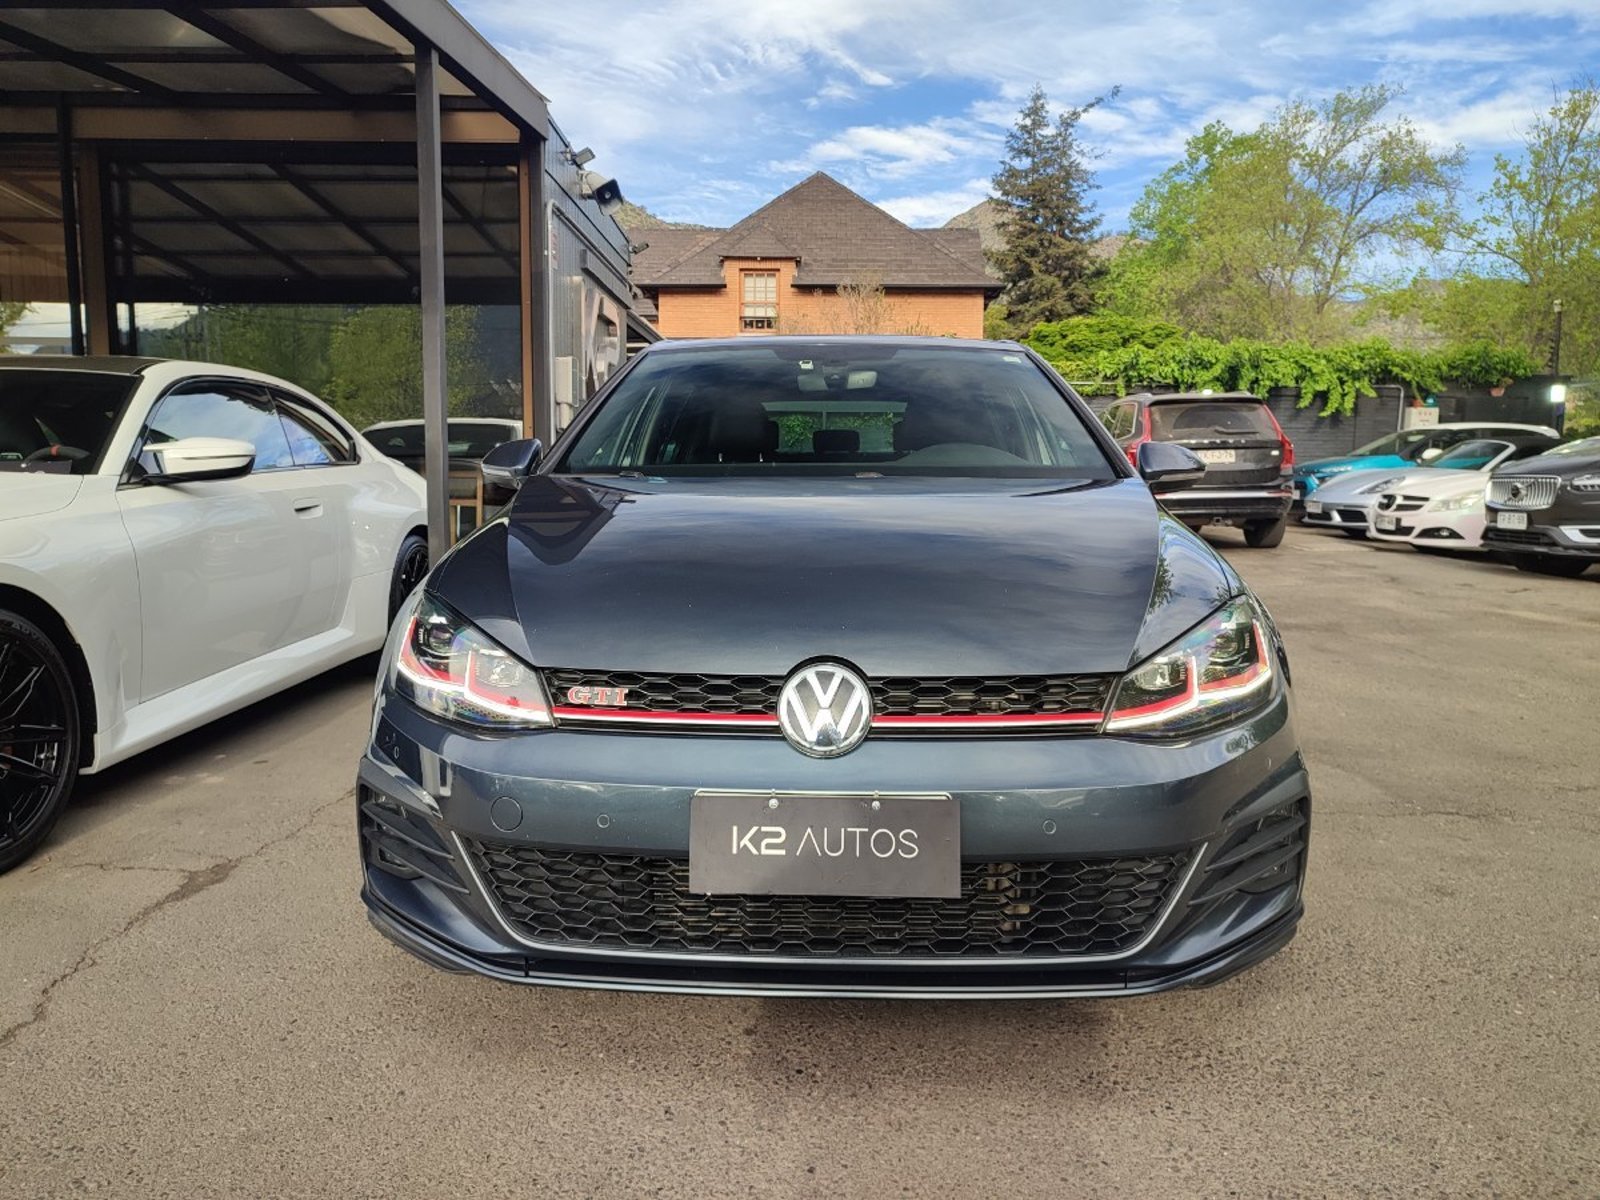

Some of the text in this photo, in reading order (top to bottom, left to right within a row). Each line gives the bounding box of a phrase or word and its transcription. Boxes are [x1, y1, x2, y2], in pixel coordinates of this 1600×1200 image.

[567, 686, 629, 706] GTI
[732, 825, 919, 858] K2 AUTOS
